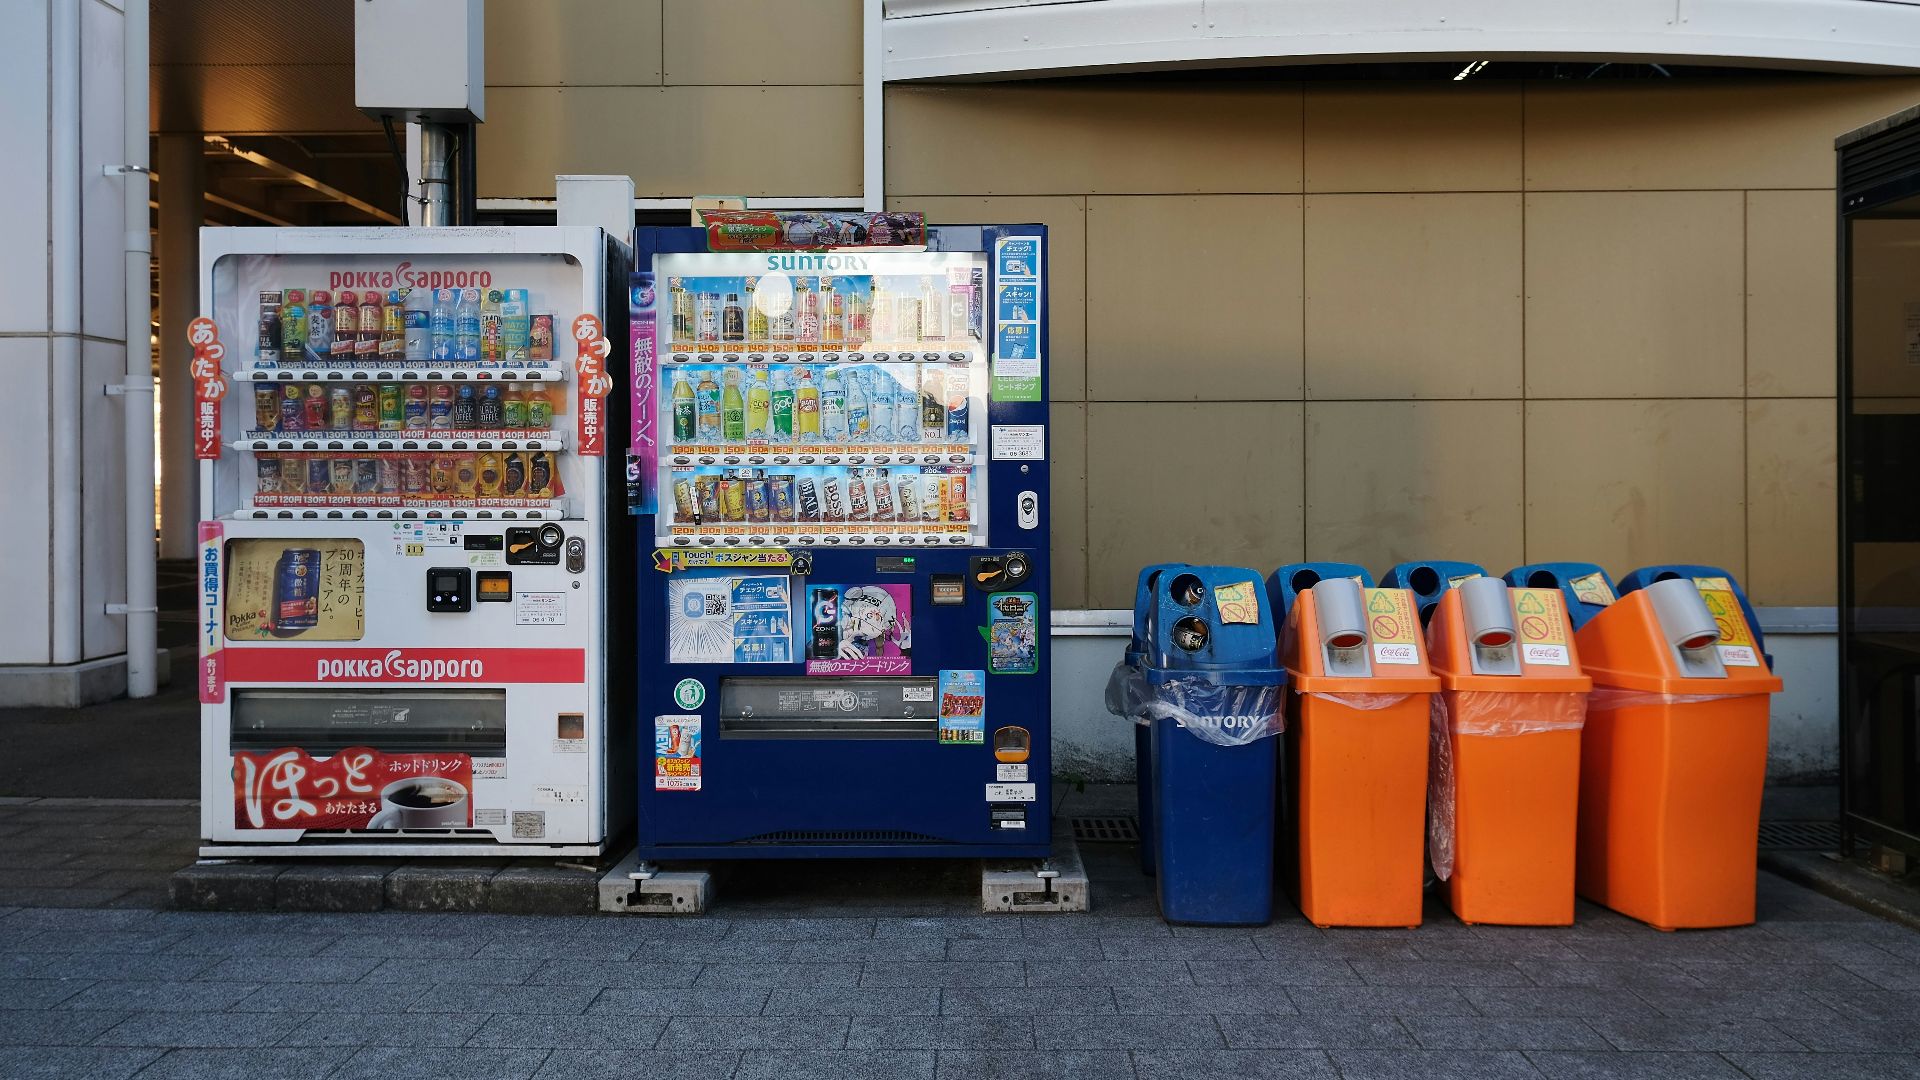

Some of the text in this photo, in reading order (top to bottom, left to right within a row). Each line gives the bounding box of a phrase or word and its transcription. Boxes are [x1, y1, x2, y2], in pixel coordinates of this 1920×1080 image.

[192, 322, 225, 398] あったか
[575, 318, 608, 395] あったか
[634, 337, 655, 447] 無敵のゾーンへ。
[200, 401, 215, 452] 販売中!
[583, 398, 598, 449] 販売中!
[402, 430, 425, 439] 140円
[427, 430, 450, 439] 140円
[452, 430, 475, 439] 140円
[477, 430, 500, 439] 140円
[502, 430, 525, 439] 140円
[527, 430, 550, 439] 140円
[255, 495, 277, 504] 120円
[279, 495, 301, 504] 120円
[304, 495, 326, 504] 130円
[328, 495, 351, 504] 120円
[353, 495, 376, 504] 120円
[377, 495, 400, 504] 120円
[403, 500, 426, 508] 120円
[427, 500, 449, 508] 150円
[683, 551, 714, 559] Touch!
[337, 549, 355, 606] 50周年の
[203, 547, 219, 697] お買得コーナー あります。
[808, 660, 910, 673] 無敵のエナジードリンク
[389, 759, 463, 774] ホットドリンク
[242, 751, 373, 828] ほっと
[325, 802, 378, 815] あたたまる
